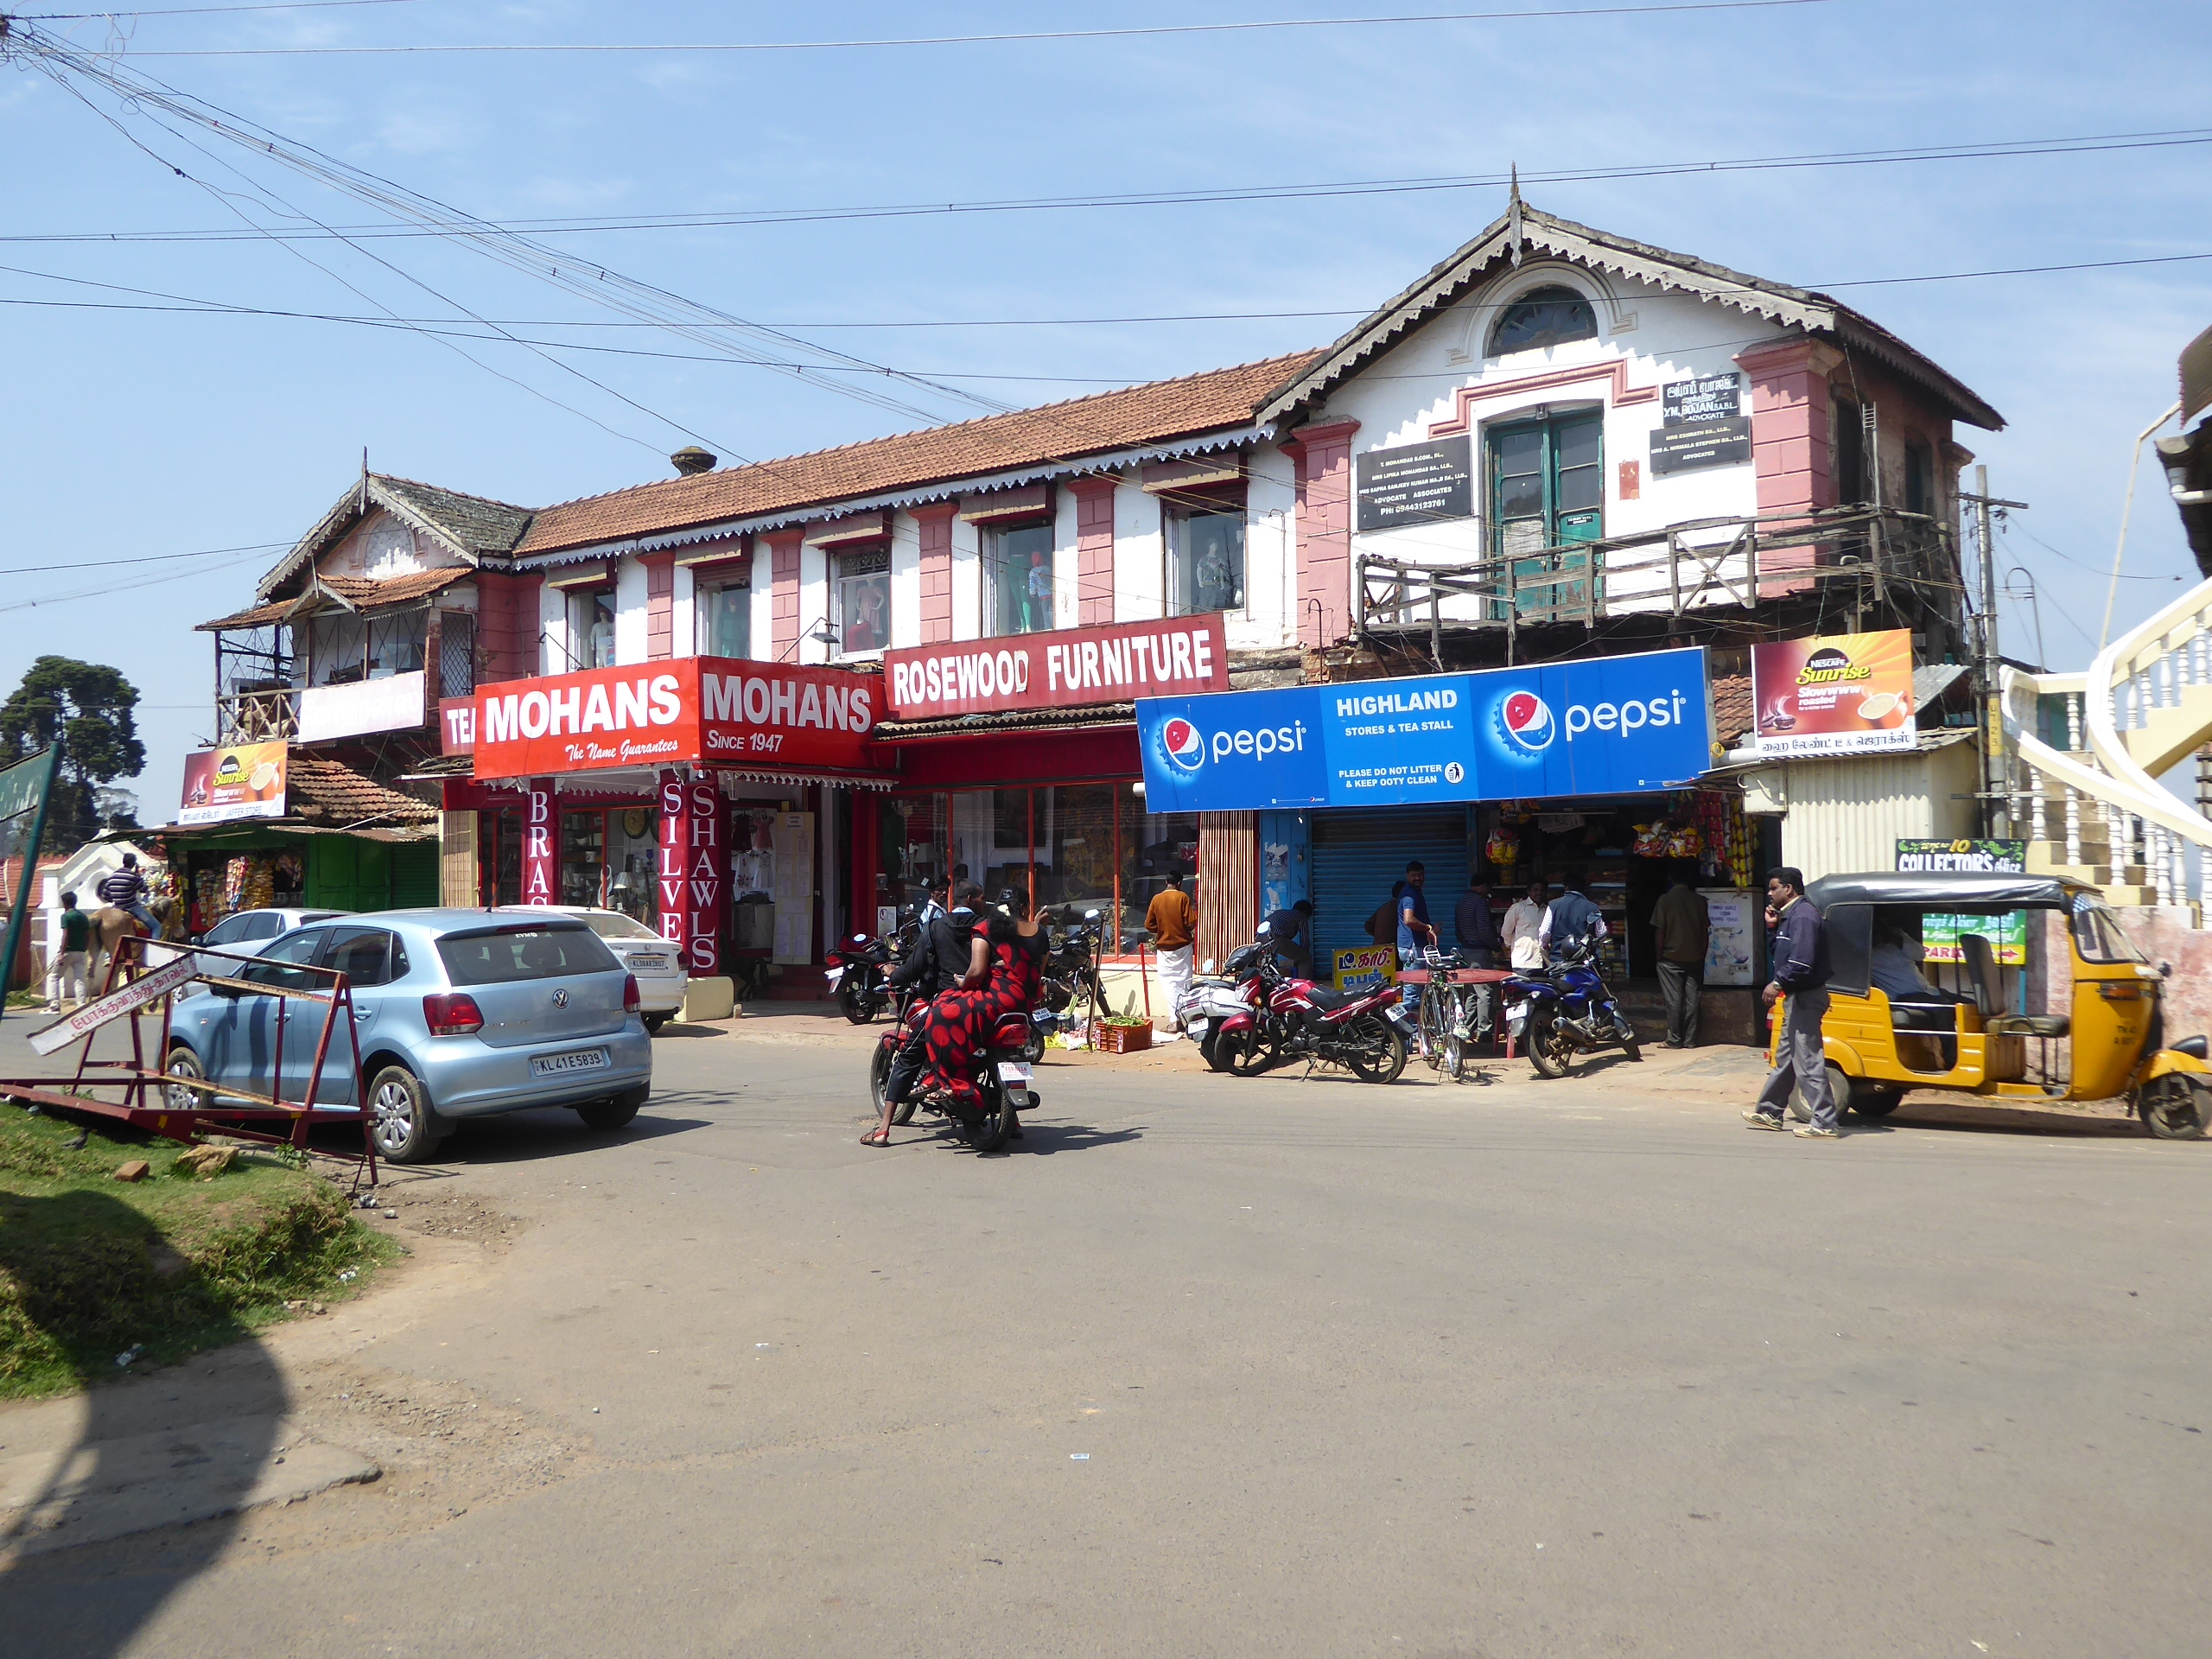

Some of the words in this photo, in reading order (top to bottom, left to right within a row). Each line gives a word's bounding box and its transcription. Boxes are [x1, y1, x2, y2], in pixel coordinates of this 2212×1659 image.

[1682, 451, 1715, 460] ADVOCATES
[1374, 493, 1407, 504] ADVOCATE
[1413, 486, 1452, 498] ASSOCIATES
[893, 650, 1029, 706] ROSEWOOD
[1046, 629, 1213, 691] FURNITURE
[1796, 663, 1871, 685] Sunrise
[486, 674, 681, 743] MOHANS
[702, 673, 871, 733] MOHANS
[1337, 690, 1458, 716] HIGHLAND
[1565, 689, 1681, 741] pepsi
[1345, 726, 1385, 736] STORES
[1398, 722, 1419, 732] TEA
[1421, 720, 1453, 730] STALL
[565, 744, 584, 762] The
[586, 742, 616, 760] Name
[620, 739, 678, 762] Guarantees
[749, 732, 784, 753] 1947
[1212, 720, 1303, 764] pepsi
[1339, 768, 1372, 778] PLEASE
[1374, 767, 1387, 776] DO
[1389, 766, 1408, 775] NOT
[1410, 764, 1442, 773] LITTER
[1355, 779, 1377, 787] KEEP
[1380, 778, 1404, 786] OOTY
[1407, 775, 1437, 785] CLEAN
[245, 805, 262, 815] STORE
[690, 786, 719, 969] SHAWLS
